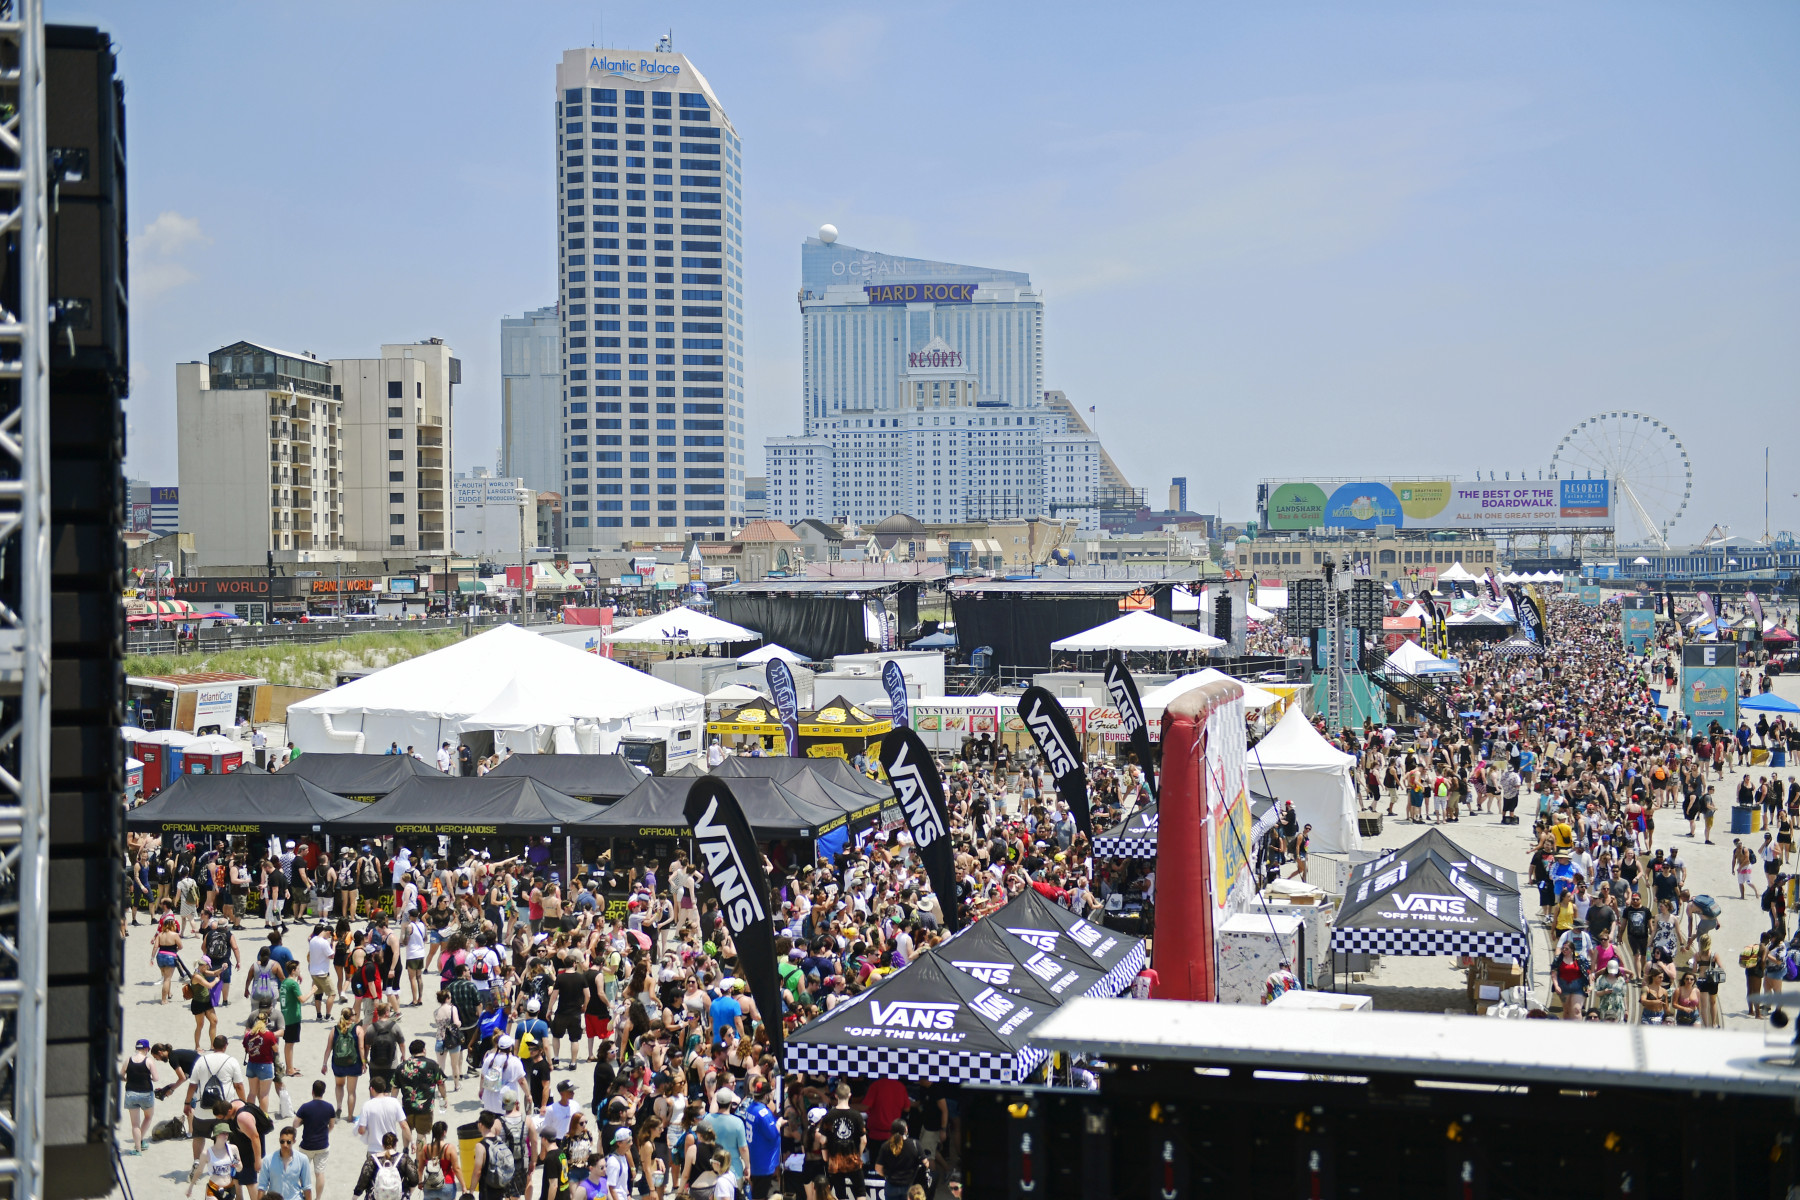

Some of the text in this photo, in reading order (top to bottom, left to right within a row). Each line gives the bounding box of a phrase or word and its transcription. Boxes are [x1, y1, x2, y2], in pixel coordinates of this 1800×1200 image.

[590, 56, 680, 75] Atlantic Palace
[869, 284, 972, 302] HARD ROCK
[910, 351, 962, 368] RESORTS
[1458, 489, 1554, 499] THE BEST OF THE
[1564, 483, 1604, 493] RESORTS
[1276, 505, 1322, 513] LANDSHARK
[1481, 499, 1558, 508] BOARDWALK.
[1300, 512, 1320, 520] Grill
[1456, 512, 1472, 520] ALL
[1473, 512, 1483, 520] IN
[1484, 512, 1503, 520] ONE
[1504, 511, 1531, 520] GREAT
[1533, 511, 1557, 519] SPOT.
[216, 581, 269, 593] WORLD
[346, 579, 374, 591] WORLD
[1587, 578, 1594, 586] G
[1636, 598, 1644, 609] F
[1520, 597, 1540, 627] VANS
[1703, 647, 1716, 665] E
[199, 690, 233, 702] AtlantiCare
[1107, 664, 1144, 736] VANS
[917, 707, 994, 715] NY STYLE PIZZA
[1004, 707, 1018, 716] NY
[1094, 720, 1119, 730] Fries
[1026, 697, 1079, 780] VANS
[888, 740, 946, 848] VANS
[161, 824, 260, 833] OFFICIAL MERCHANDISE
[395, 825, 497, 834] OFFICIAL MERCHANDISE
[638, 828, 678, 836] OFFICIAL
[693, 794, 765, 933] VANS
[1391, 893, 1467, 915] VANS
[1377, 911, 1479, 924] "OFF THE WALL"
[1065, 918, 1103, 948] VANS
[1023, 950, 1064, 982] VANS
[968, 986, 1015, 1022] VANS
[869, 1000, 960, 1030] VANS
[844, 1026, 966, 1043] "OFF THE WALL"
